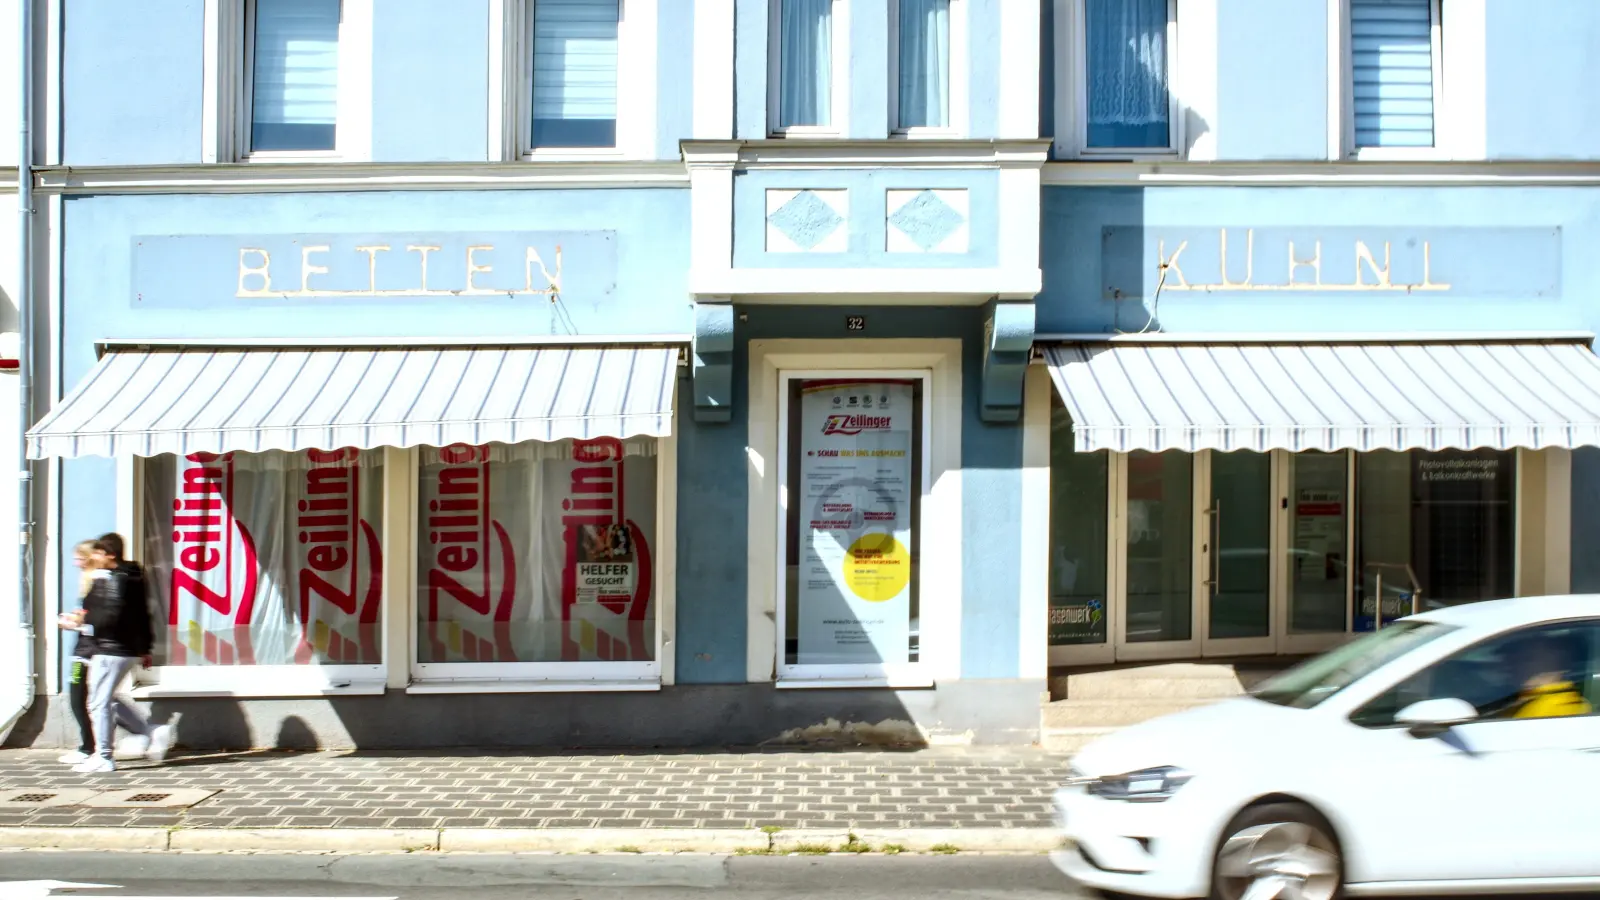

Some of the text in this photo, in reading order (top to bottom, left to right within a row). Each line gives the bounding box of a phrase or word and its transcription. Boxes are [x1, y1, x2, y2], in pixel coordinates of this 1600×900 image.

[234, 243, 562, 298] BETTEN
[848, 316, 864, 330] 32
[827, 413, 892, 430] Zeilinger
[580, 564, 629, 576] HELFER
[585, 576, 625, 586] GESUCHT
